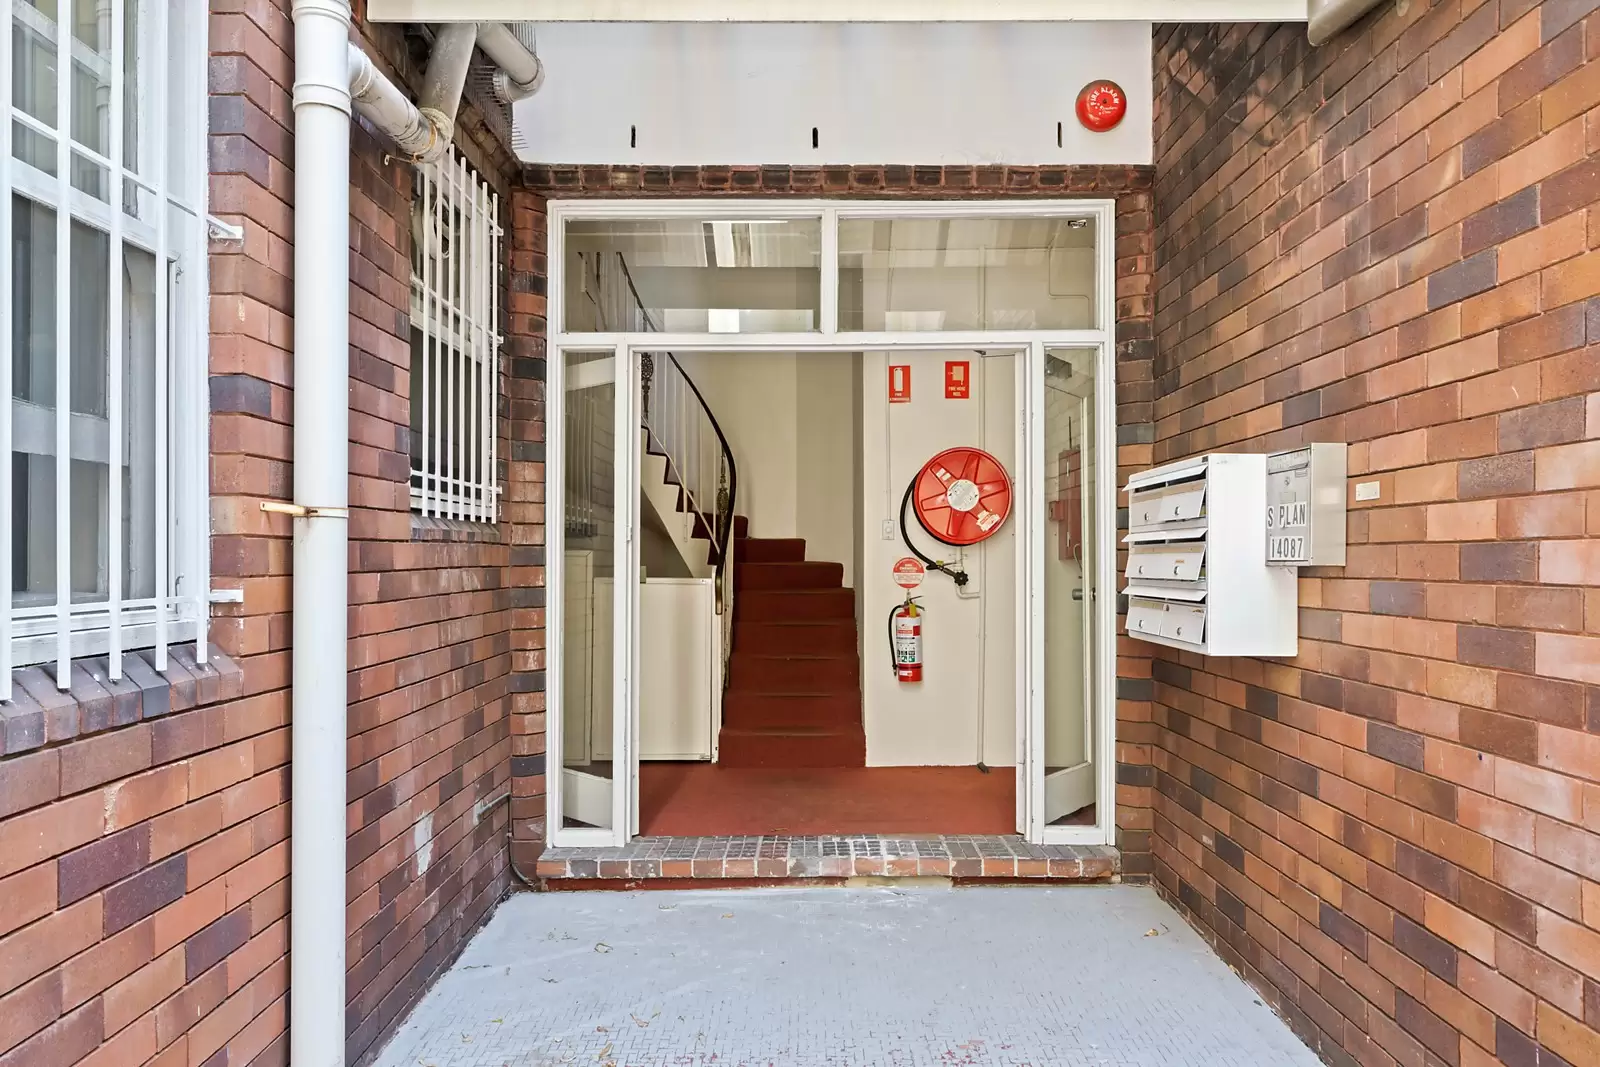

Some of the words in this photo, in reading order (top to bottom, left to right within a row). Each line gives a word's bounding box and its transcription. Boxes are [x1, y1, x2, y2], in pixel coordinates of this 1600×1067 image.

[1090, 90, 1100, 106] FIRE
[1101, 87, 1119, 104] ALARM
[1267, 507, 1274, 528] S
[1279, 503, 1306, 526] PLAN
